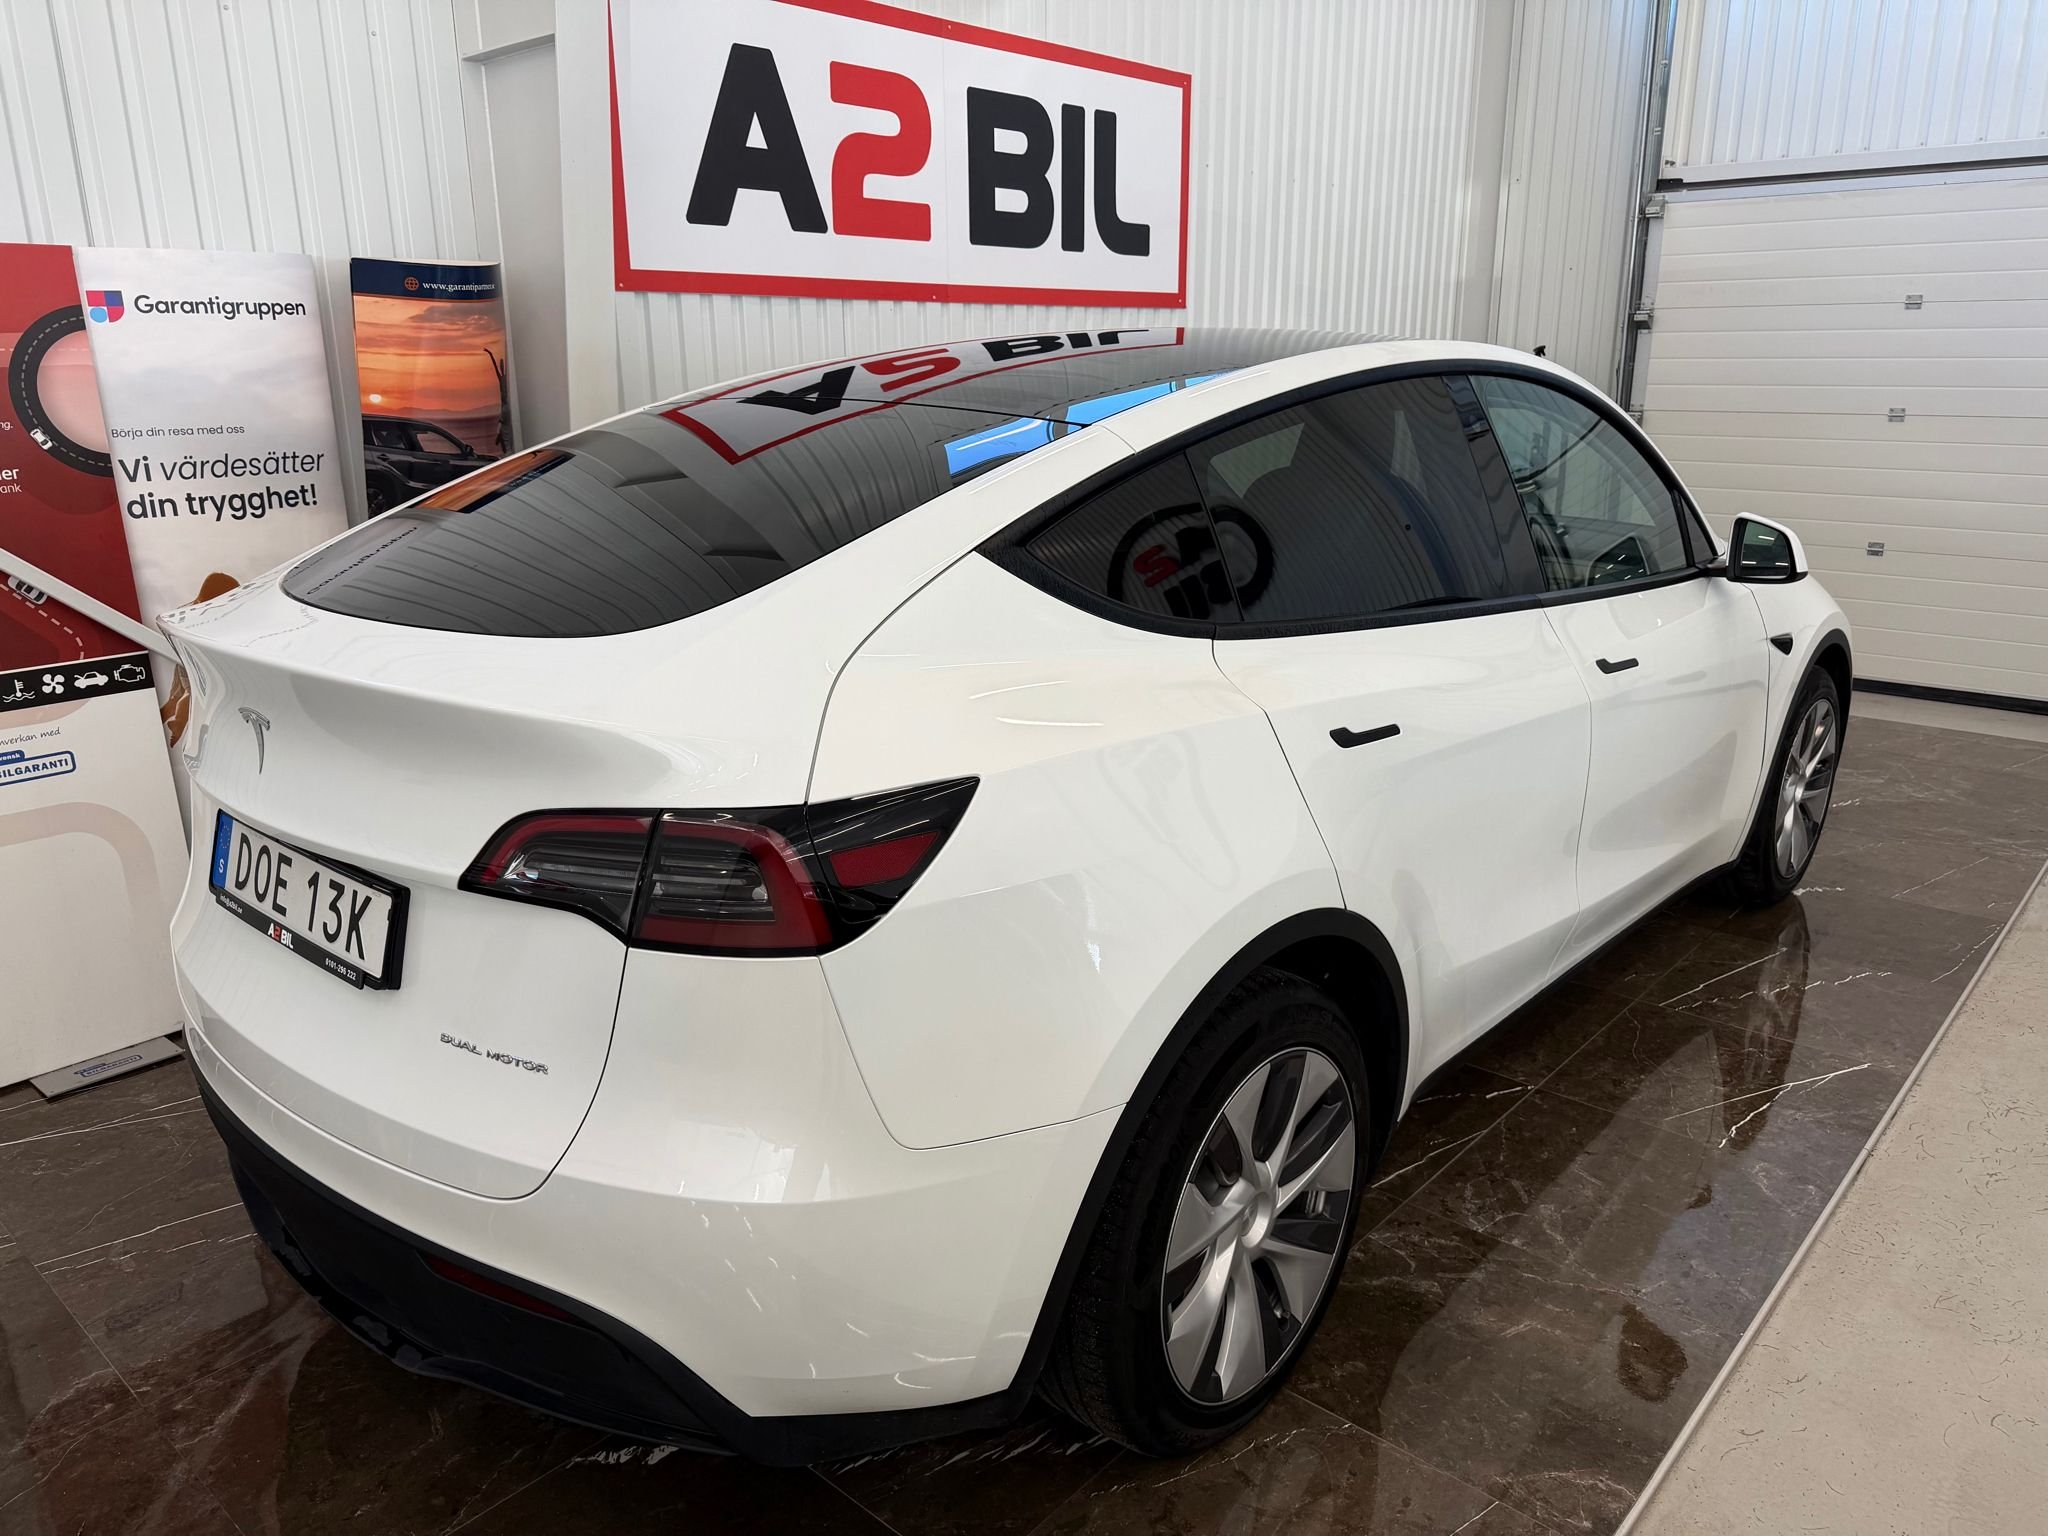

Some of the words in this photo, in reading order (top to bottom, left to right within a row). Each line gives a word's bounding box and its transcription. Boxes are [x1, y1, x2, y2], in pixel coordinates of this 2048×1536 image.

[685, 42, 933, 242] A2
[966, 86, 1151, 257] BIL
[133, 294, 307, 321] Garantigruppen
[111, 424, 144, 439] Börja
[146, 424, 167, 437] din
[168, 427, 195, 437] resa
[197, 424, 224, 436] med
[226, 426, 245, 435] oss
[0, 468, 19, 480] er
[118, 455, 152, 484] Vi
[160, 451, 325, 481] värdesätter
[126, 493, 179, 519] din
[185, 484, 318, 522] trygghet!
[40, 726, 61, 738] med
[218, 858, 225, 873] S
[234, 832, 293, 917] DOE
[307, 871, 372, 961] 13K
[268, 923, 282, 940] A2
[281, 930, 294, 949] BIL
[440, 1032, 483, 1056] DUAL
[486, 1048, 549, 1075] MOTOR
